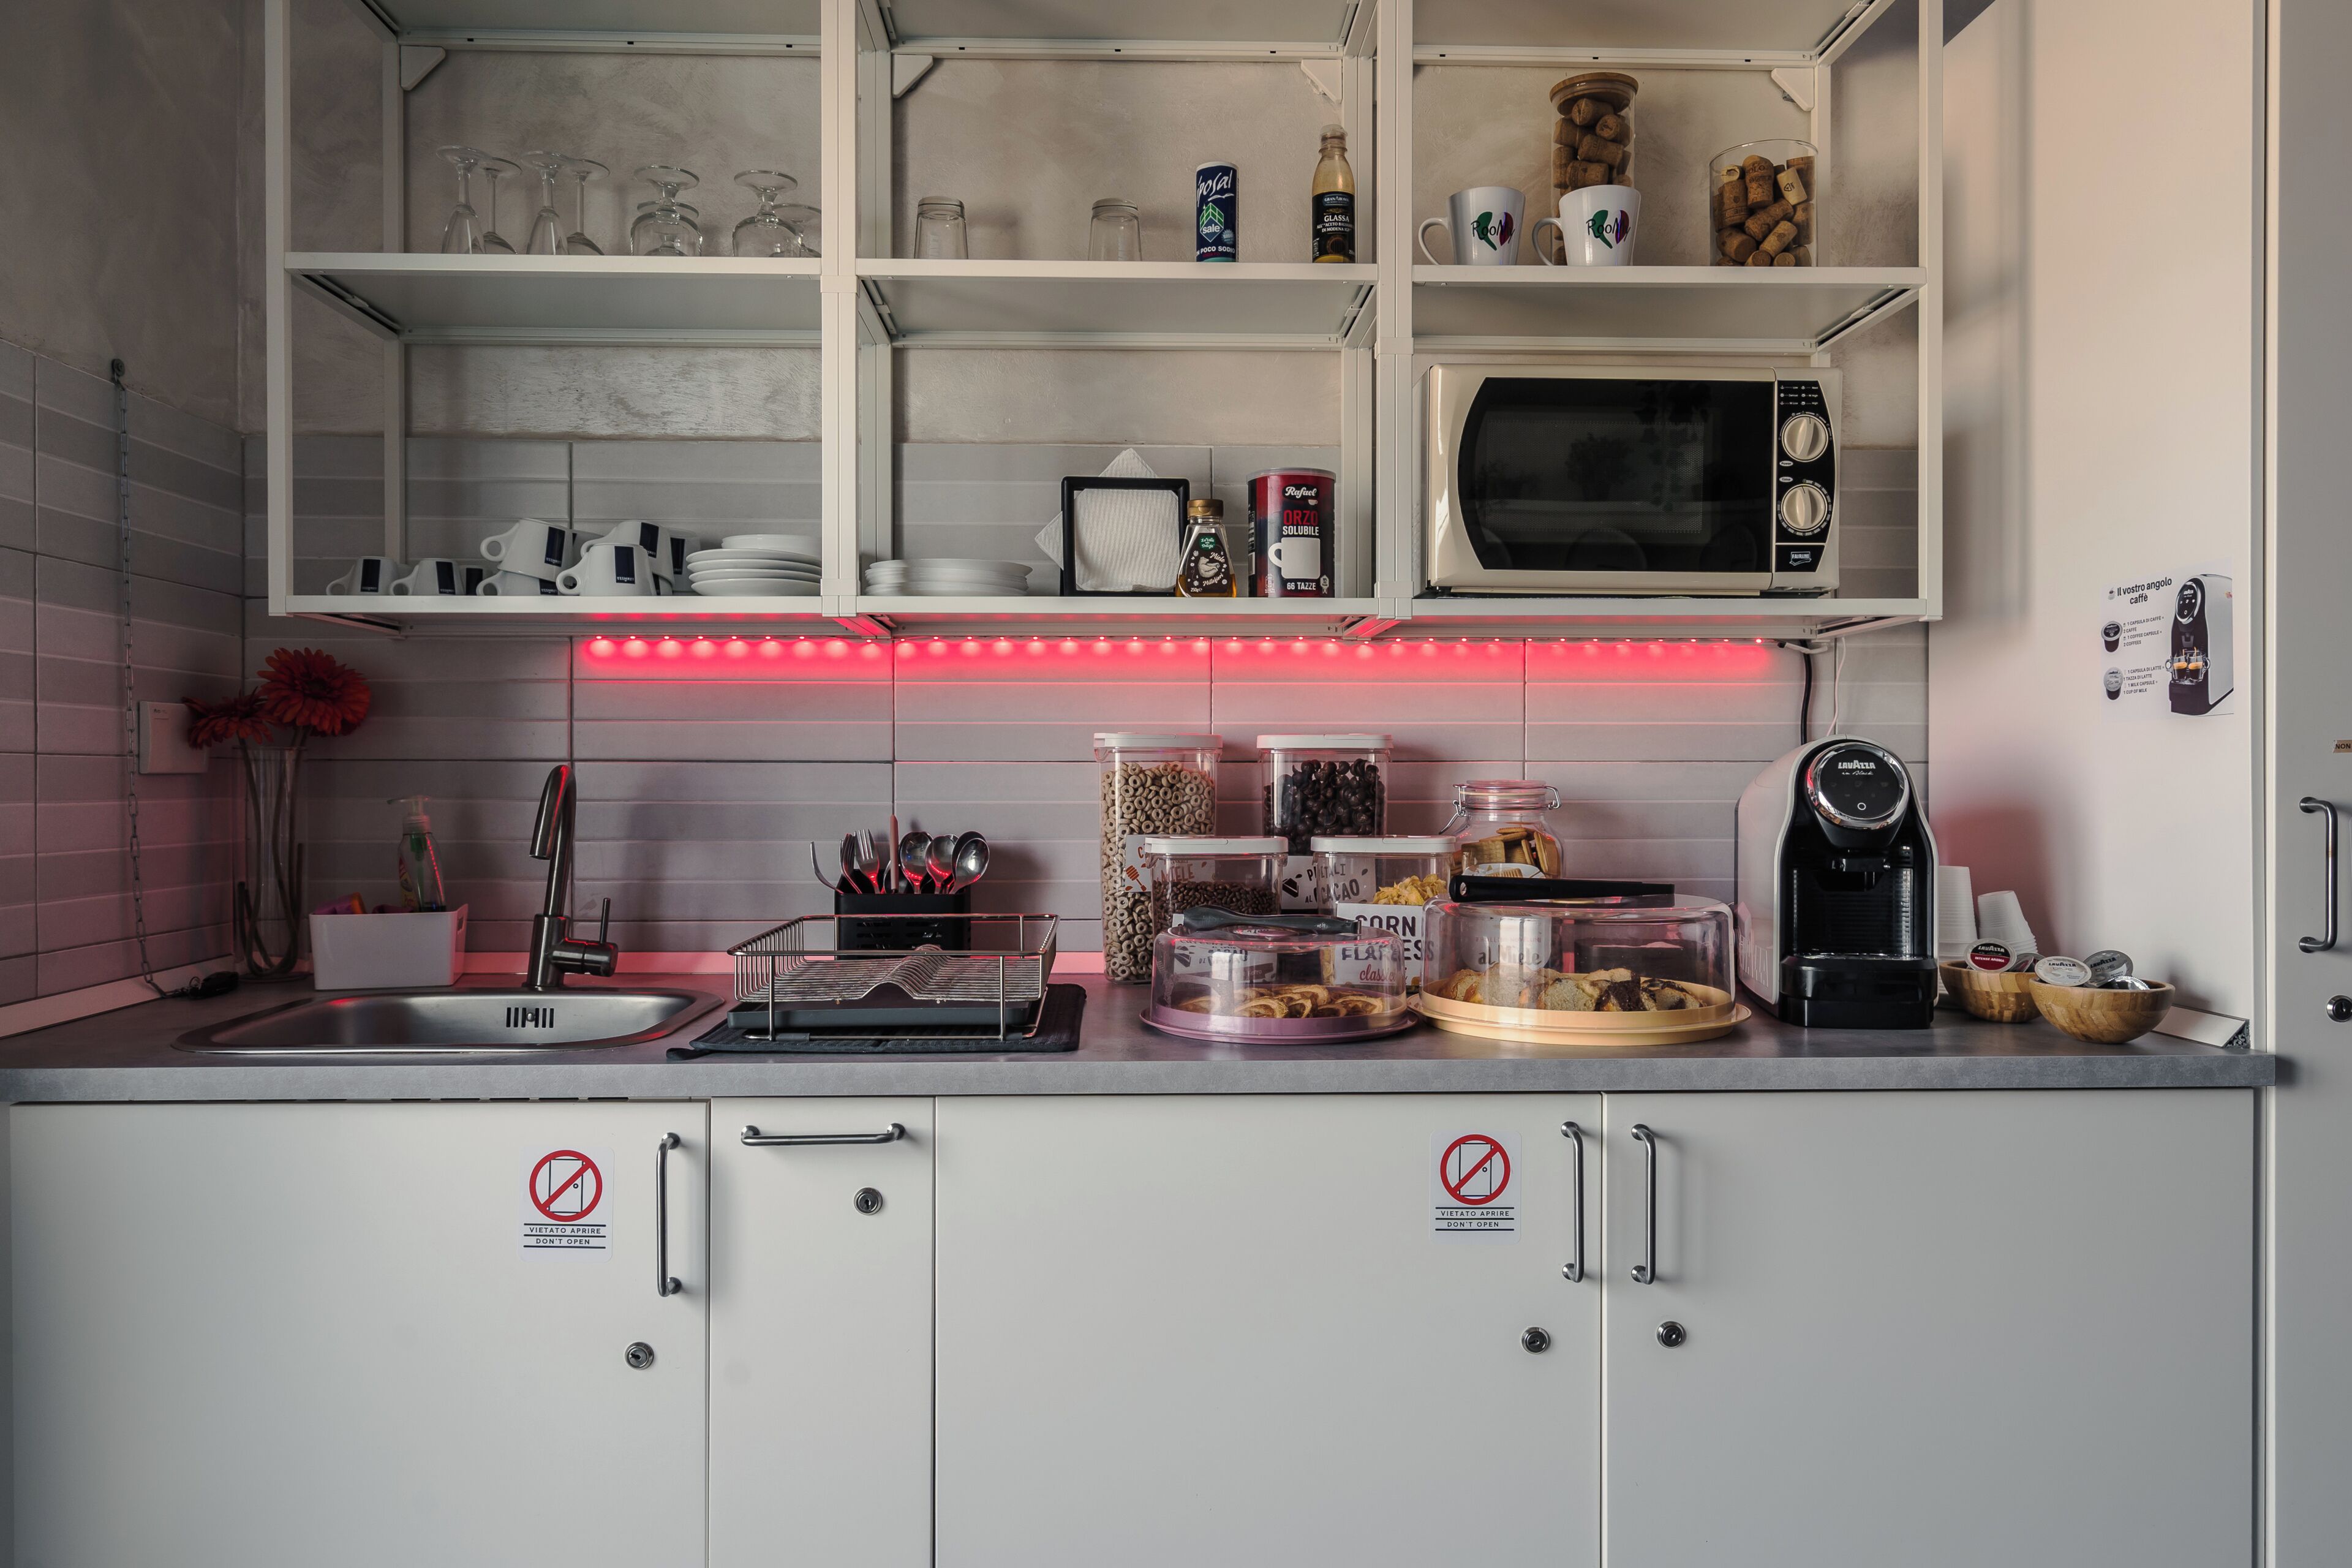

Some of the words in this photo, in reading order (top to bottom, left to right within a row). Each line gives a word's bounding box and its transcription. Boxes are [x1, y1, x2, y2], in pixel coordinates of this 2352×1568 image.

[1202, 224, 1221, 234] sale
[1200, 246, 1216, 254] POCO
[1284, 486, 1317, 499] Rafael
[1283, 509, 1318, 526] ORZO
[1283, 526, 1319, 535] SOLUBILE
[1210, 552, 1225, 562] Miele
[1297, 582, 1316, 590] TAZZE
[2117, 587, 2122, 596] Il
[2122, 584, 2145, 595] vostro
[2146, 576, 2172, 590] angolo
[2130, 593, 2148, 605] caffè
[1838, 760, 1876, 769] LAVAZZA
[1305, 894, 1313, 904] AL
[2090, 957, 2117, 968] LAVAZZA
